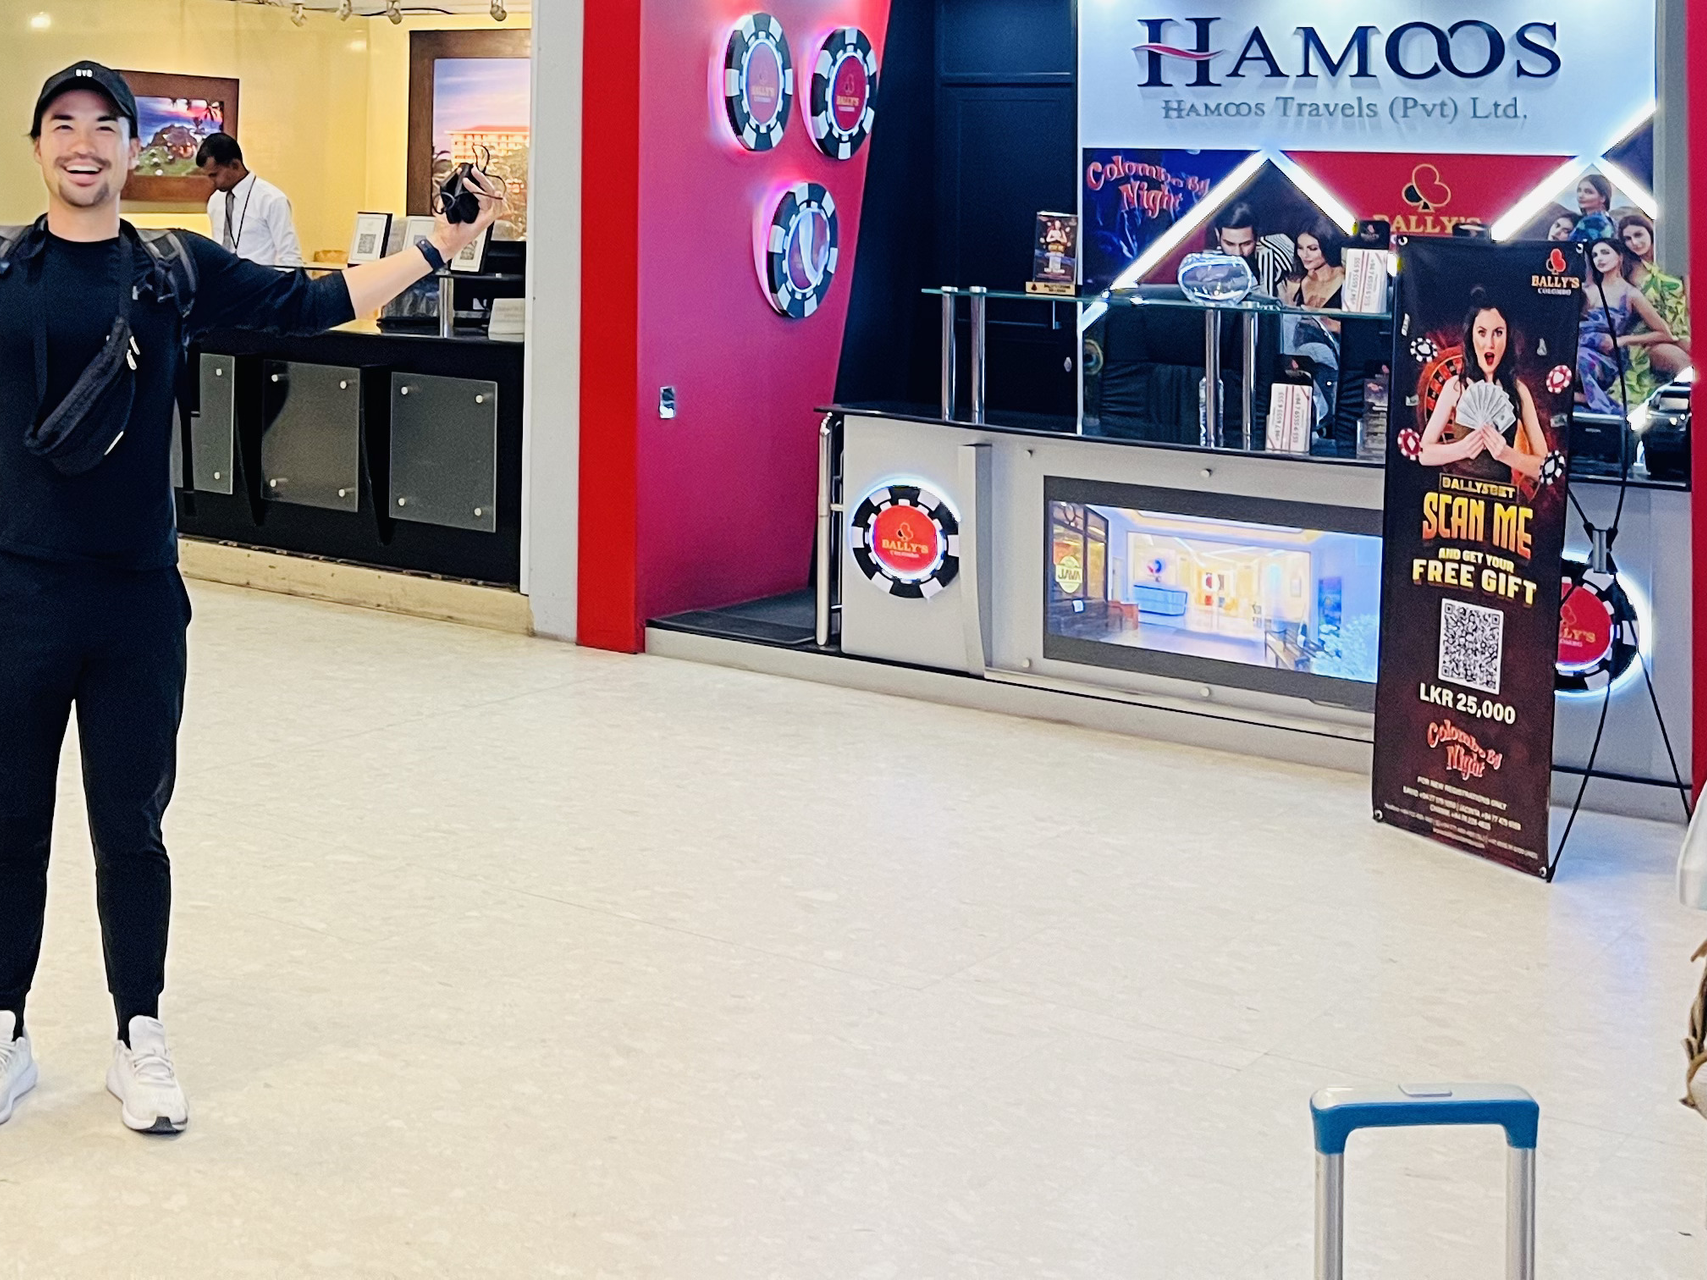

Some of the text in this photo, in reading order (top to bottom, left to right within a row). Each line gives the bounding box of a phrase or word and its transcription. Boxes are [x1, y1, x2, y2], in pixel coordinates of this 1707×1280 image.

[1132, 16, 1562, 88] HAMOOS
[1162, 97, 1266, 119] HAMOOS
[1276, 95, 1378, 119] Travels
[1388, 95, 1459, 122] (Pvt)
[1086, 155, 1211, 196] Colombo By
[1118, 180, 1184, 219] Night
[1531, 274, 1580, 289] BALLY'S
[1422, 491, 1534, 561] SCAN ME
[881, 539, 929, 555] BALLY'S
[1438, 547, 1515, 574] AND GET YOUR
[1412, 558, 1538, 606] FREE GIFT
[1420, 682, 1516, 725] LKR 25,000
[1427, 719, 1503, 770] Colombo By
[1446, 742, 1485, 780] Night
